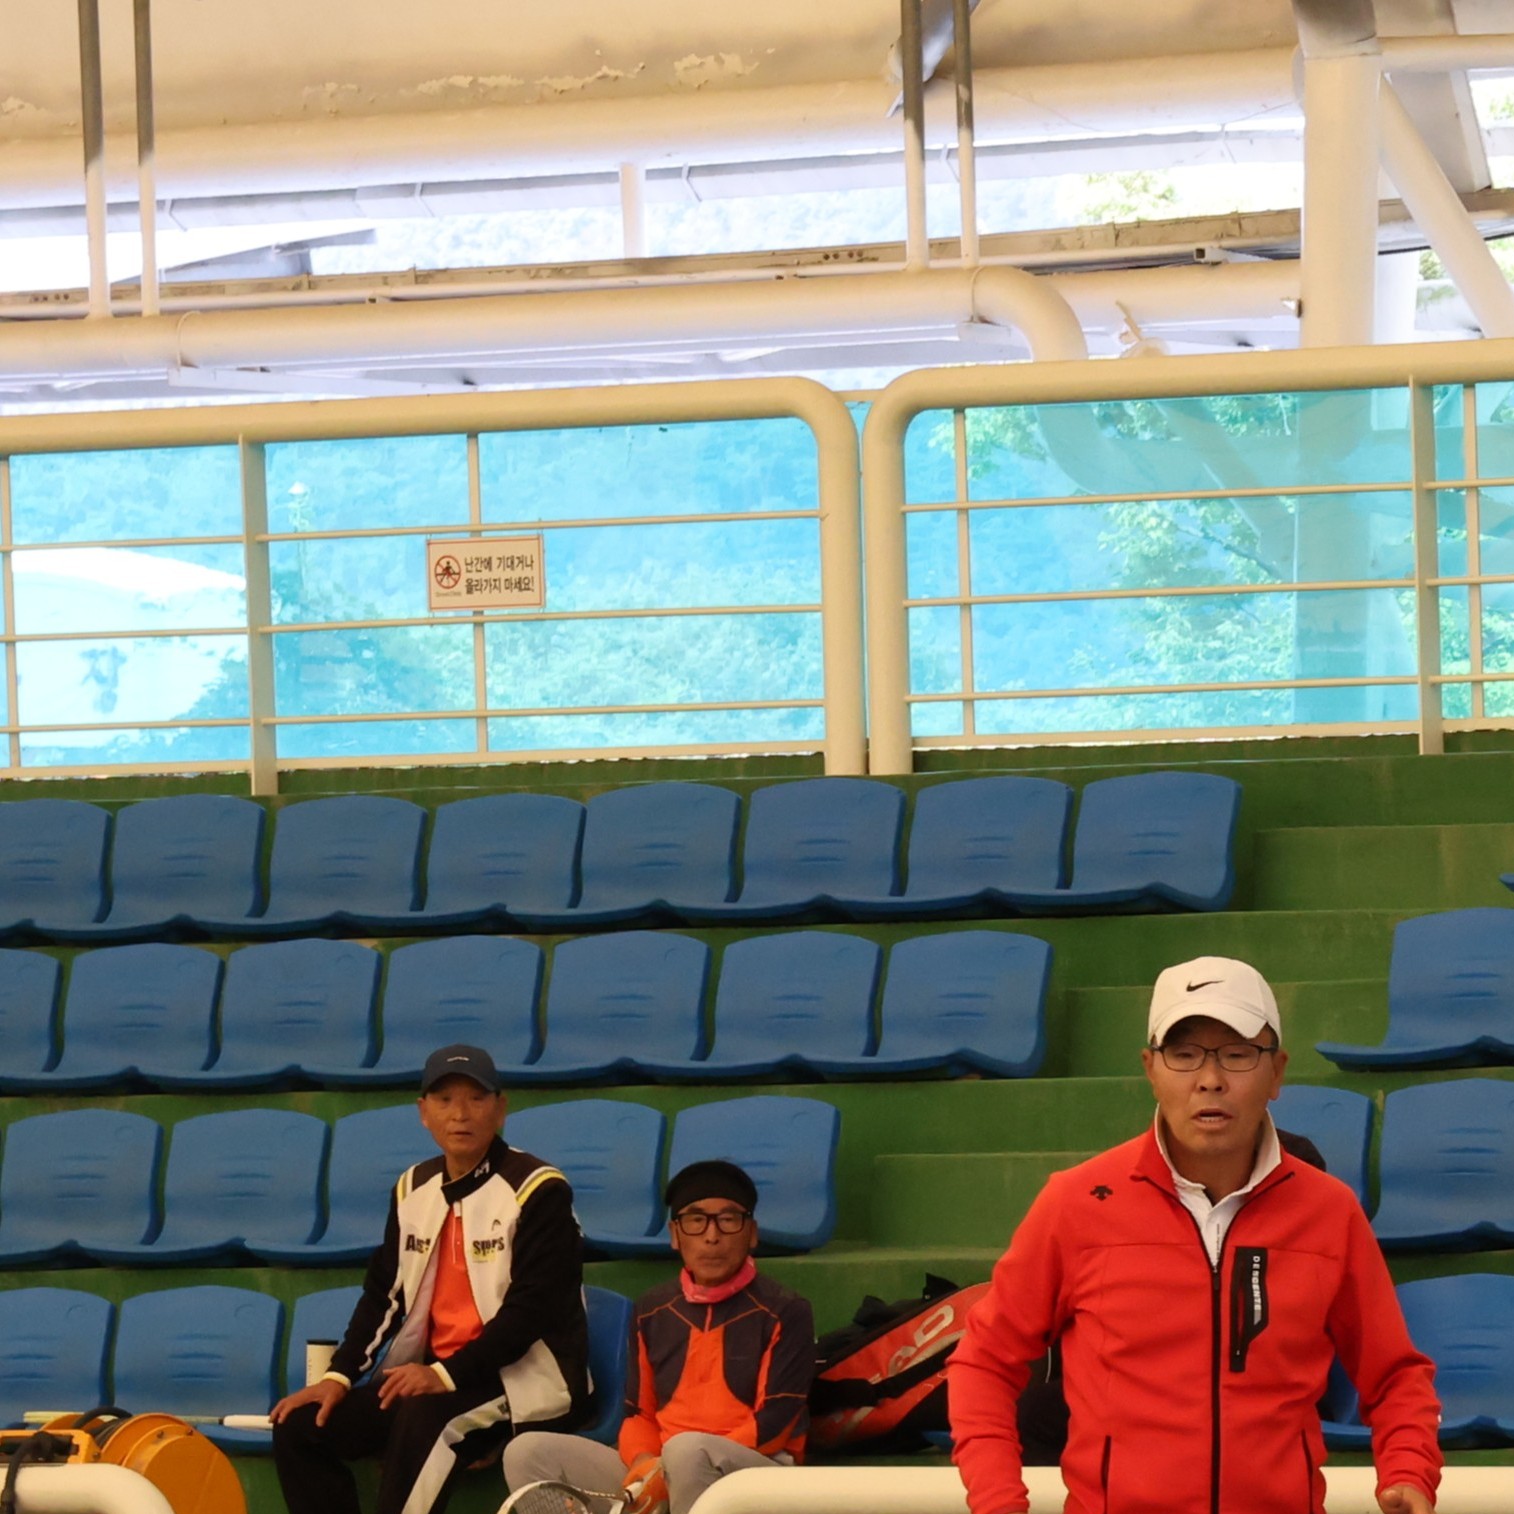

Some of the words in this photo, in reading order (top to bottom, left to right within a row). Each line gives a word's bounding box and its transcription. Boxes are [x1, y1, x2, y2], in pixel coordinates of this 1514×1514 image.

[464, 556, 493, 573] 난간에
[496, 554, 534, 572] 기대거나
[465, 577, 502, 595] 올라가지
[504, 576, 535, 593] 마세요!
[1251, 1255, 1262, 1311] DESCENTE
